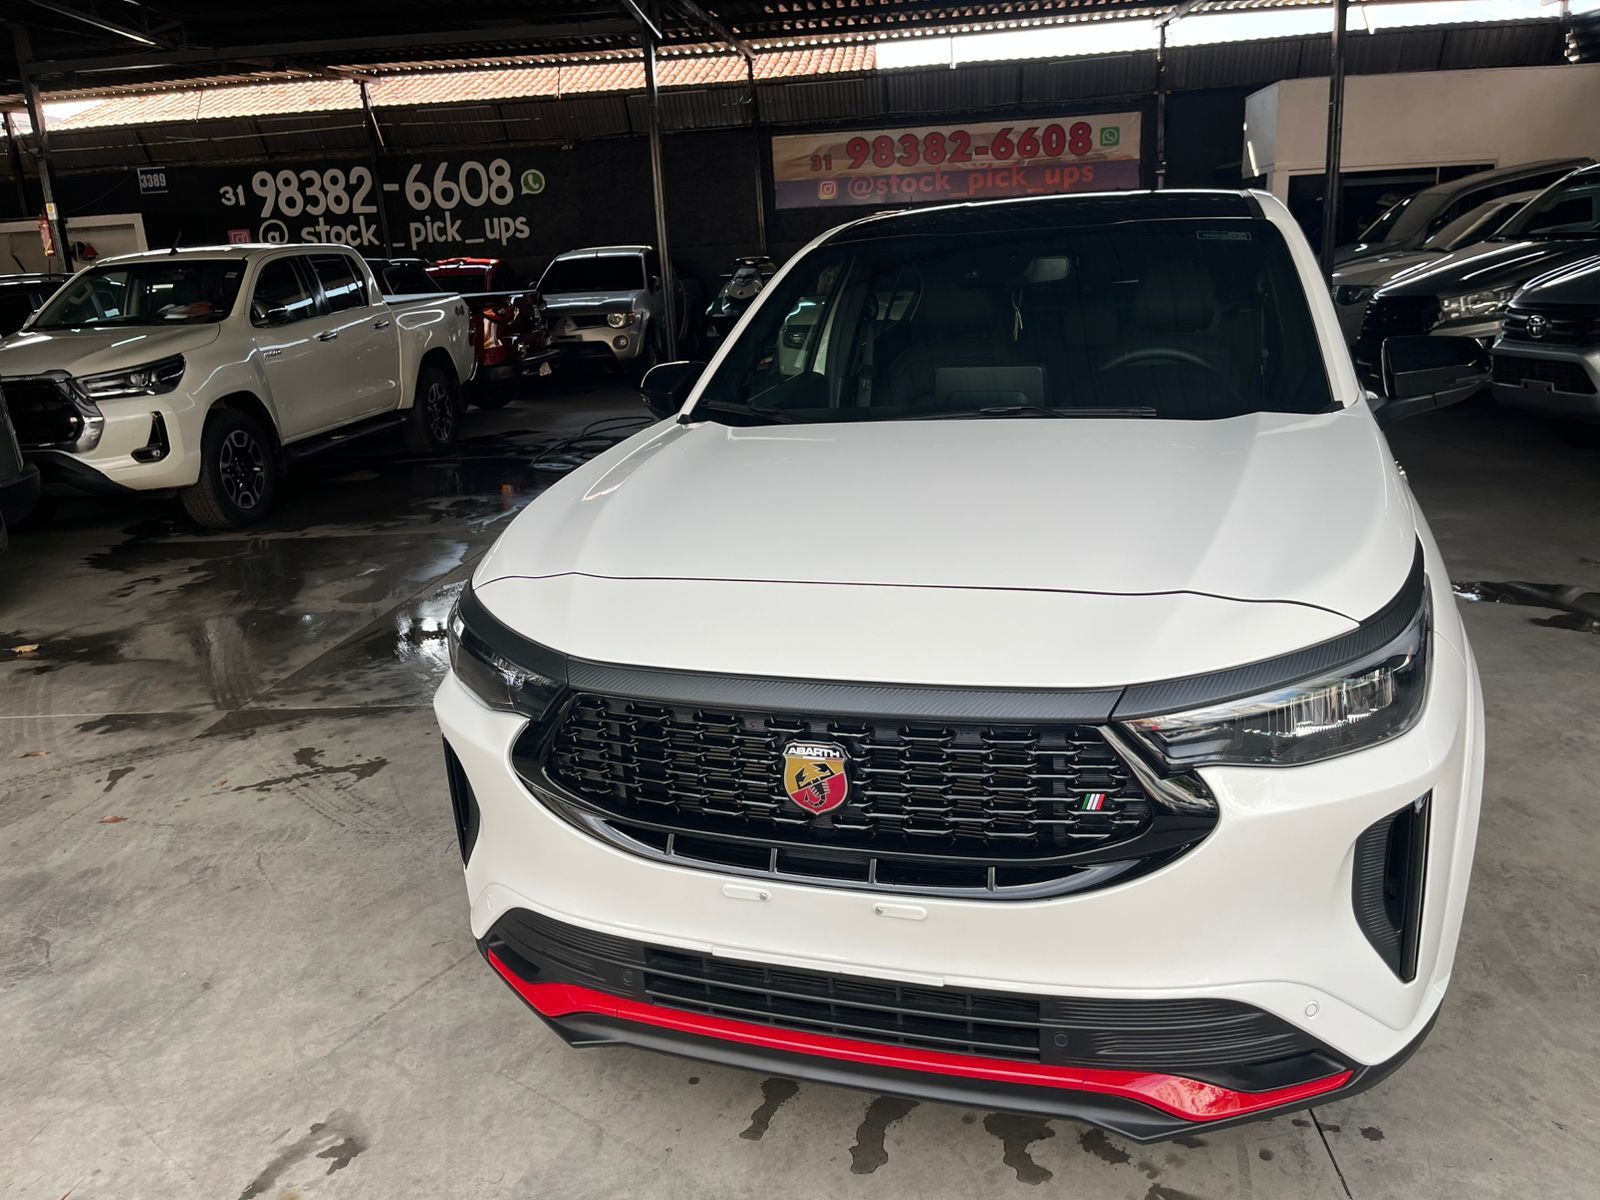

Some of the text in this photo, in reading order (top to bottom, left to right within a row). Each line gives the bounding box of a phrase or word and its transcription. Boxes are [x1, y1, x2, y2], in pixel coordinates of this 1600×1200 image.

[811, 122, 1092, 172] 31 98382-6608
[140, 173, 167, 188] 3389
[848, 163, 1095, 198] @stock_pick_ups
[219, 184, 246, 207] 31
[788, 746, 840, 758] ABARTH
